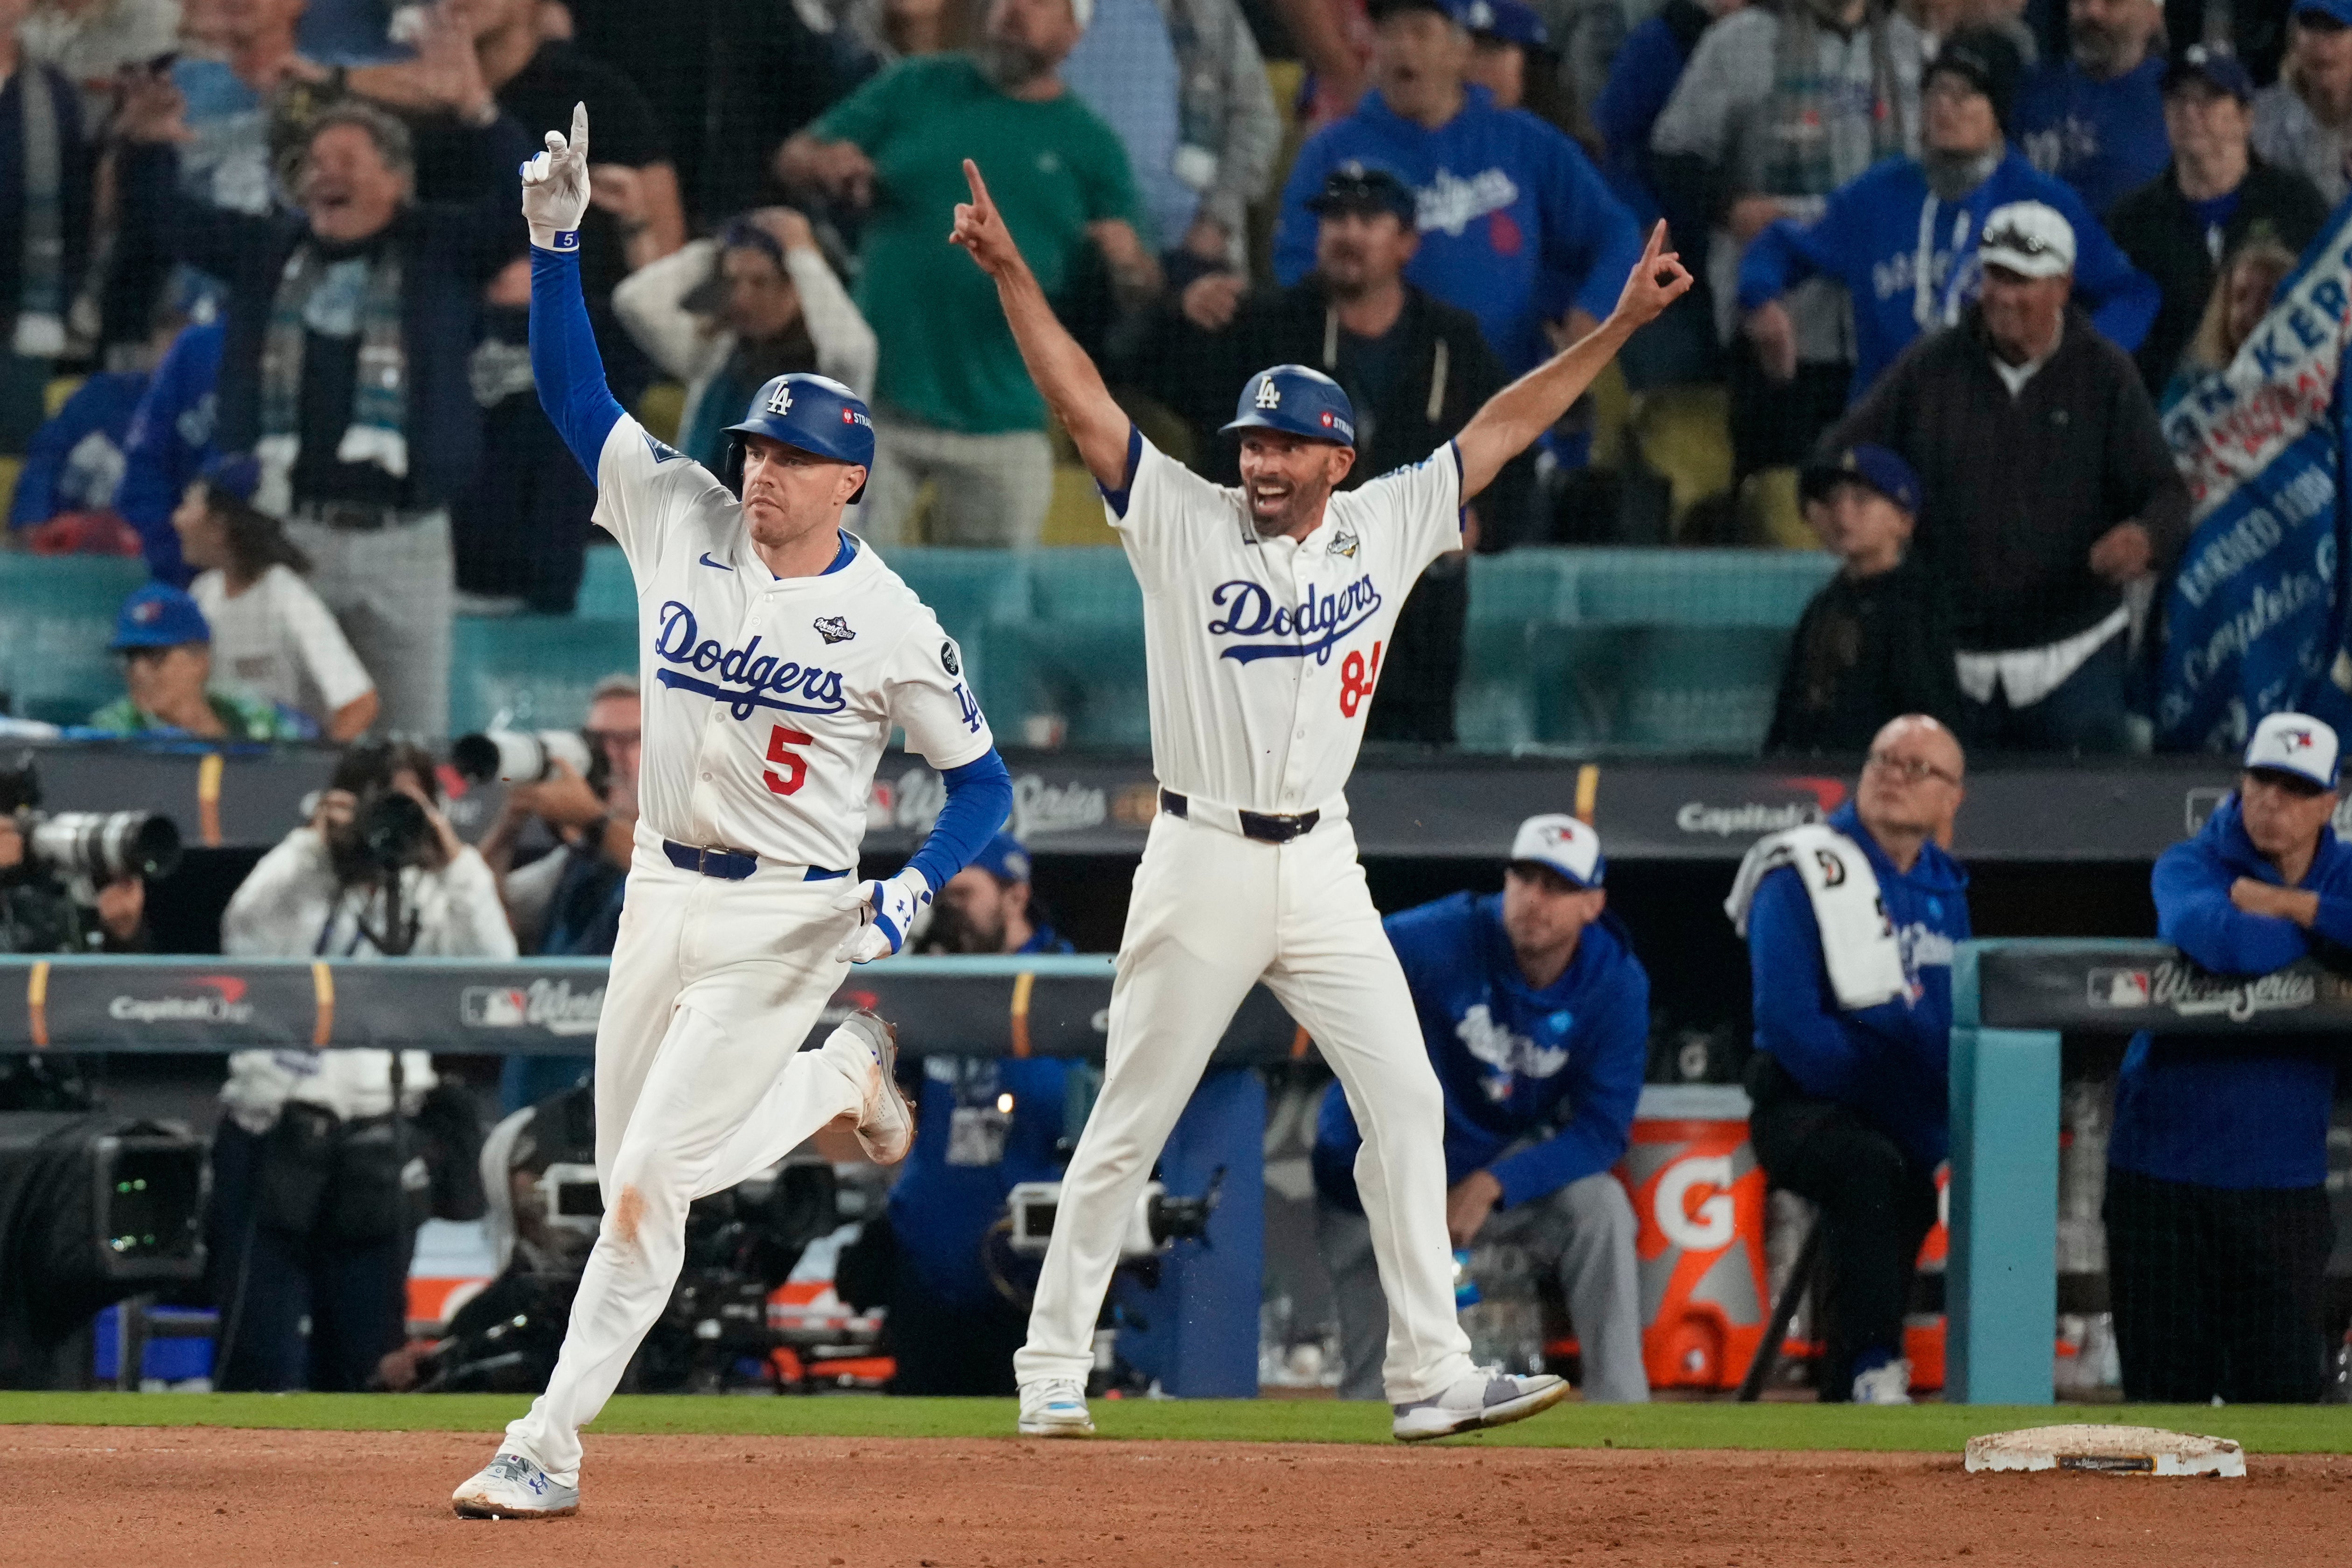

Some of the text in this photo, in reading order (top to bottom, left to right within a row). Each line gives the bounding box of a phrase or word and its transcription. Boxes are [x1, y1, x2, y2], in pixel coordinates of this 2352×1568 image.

[563, 233, 574, 246] 5
[767, 380, 793, 416] LA
[1255, 375, 1281, 409] LA
[1209, 573, 1382, 666] Dodgers
[655, 600, 847, 721] Dodgers
[952, 682, 983, 734] LA
[763, 724, 813, 795] 5
[1676, 802, 1797, 838] Capital
[1654, 1156, 1735, 1251] G
